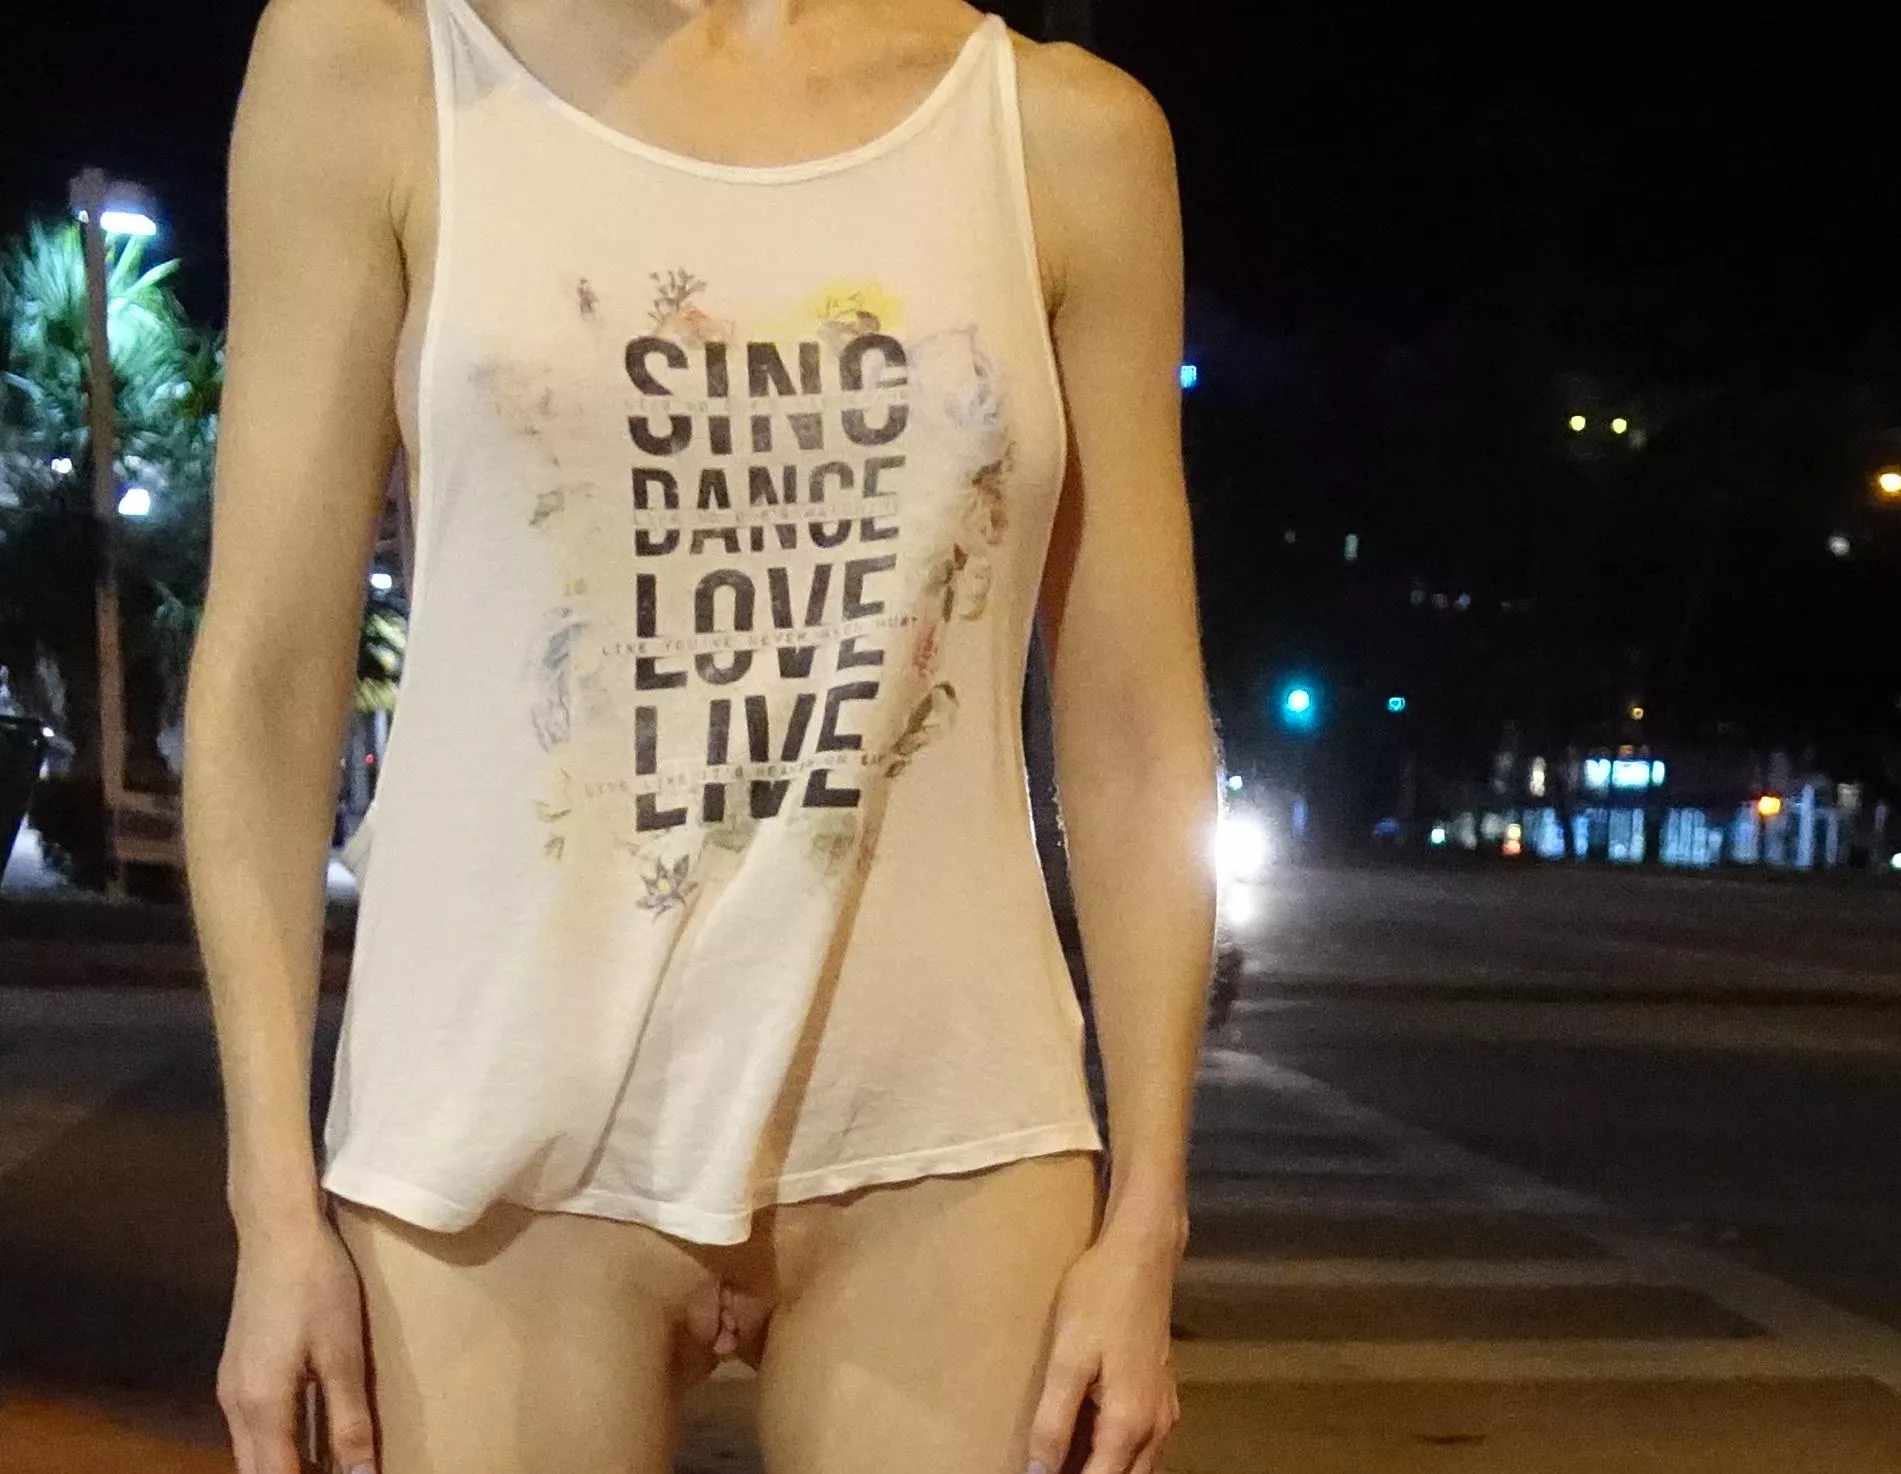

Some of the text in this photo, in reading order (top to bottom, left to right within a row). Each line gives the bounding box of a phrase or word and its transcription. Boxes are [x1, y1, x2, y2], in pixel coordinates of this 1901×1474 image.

[631, 455, 906, 557] DANCE
[635, 556, 896, 691] LOVE
[635, 681, 879, 833] LIVE
